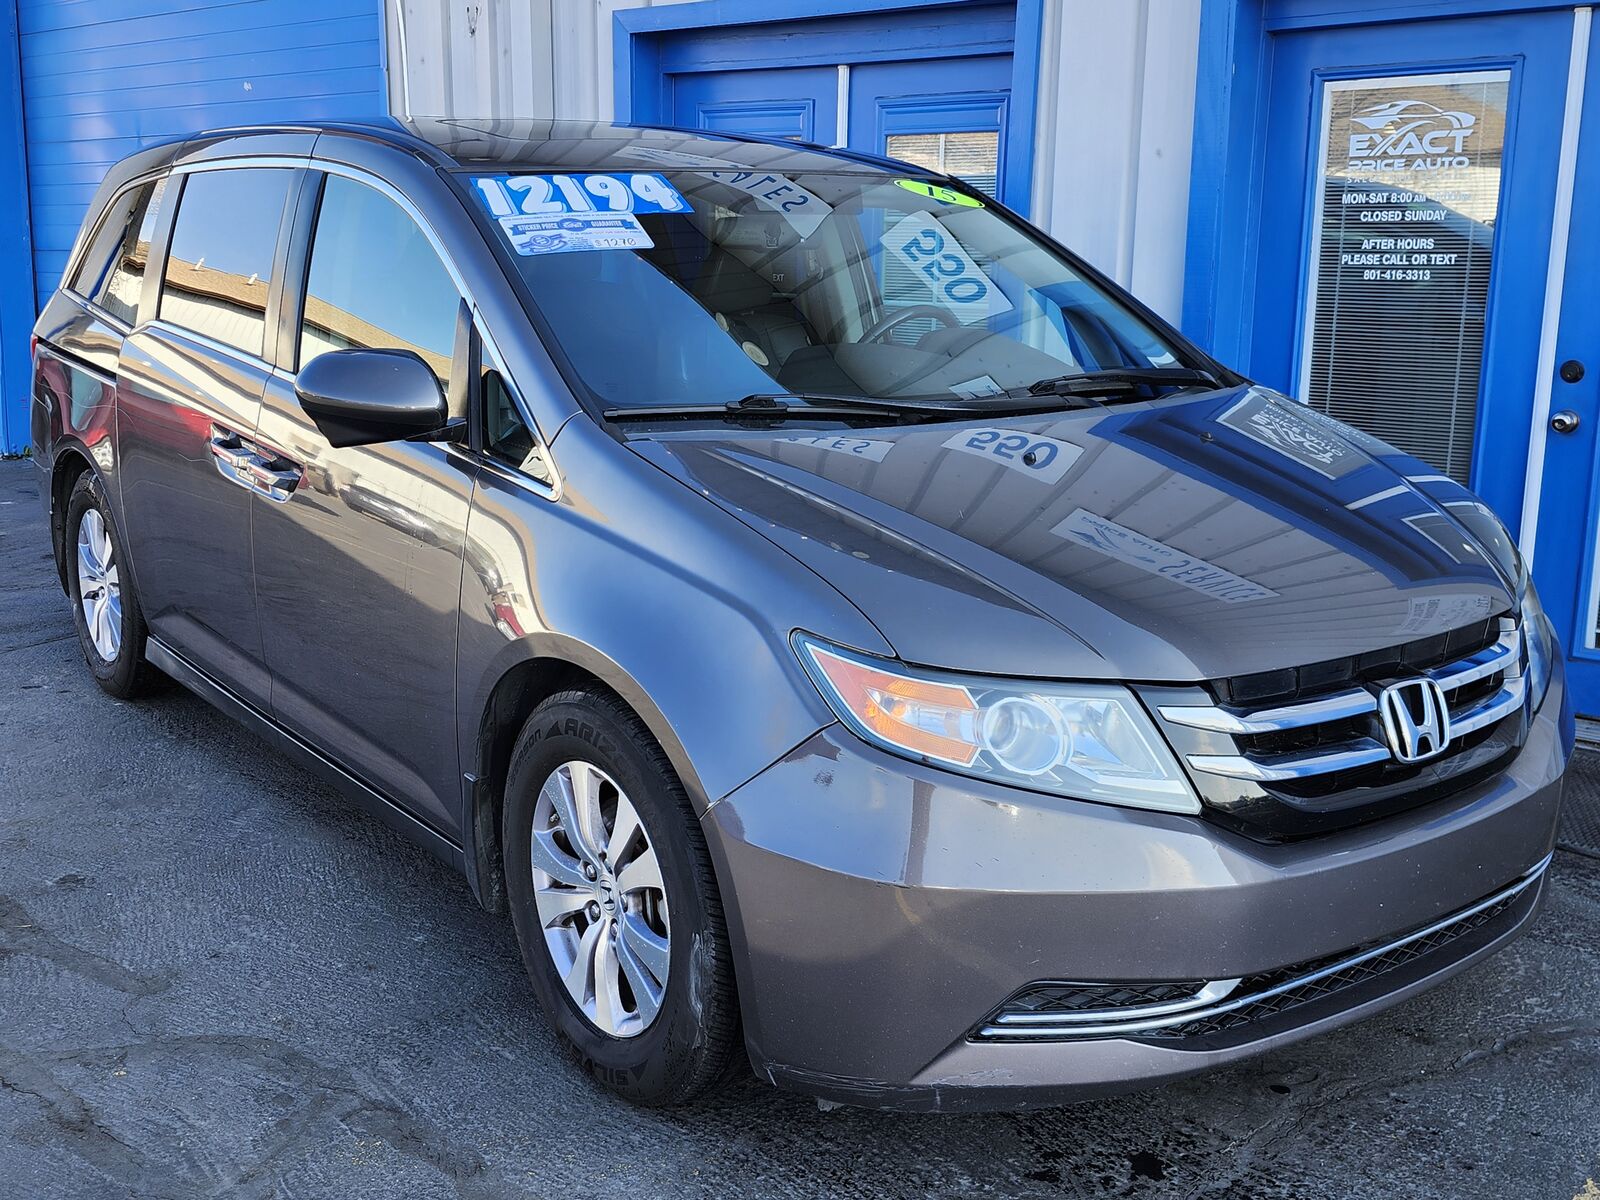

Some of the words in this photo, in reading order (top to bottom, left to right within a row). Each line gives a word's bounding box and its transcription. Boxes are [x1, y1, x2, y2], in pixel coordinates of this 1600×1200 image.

[1350, 129, 1474, 156] EXACT
[1348, 158, 1406, 172] PRICE
[1410, 156, 1470, 171] AUTO
[477, 174, 684, 216] 12194
[927, 186, 957, 201] 15
[1342, 193, 1389, 205] MON-SAT
[1390, 192, 1413, 203] 8:00
[1413, 194, 1426, 203] AM
[1360, 211, 1402, 222] CLOSED
[1404, 210, 1447, 221] SUNDAY
[517, 223, 541, 231] STICKER
[542, 222, 559, 230] PRICE
[1362, 239, 1395, 250] AFTER
[1397, 238, 1434, 249] HOURS
[1342, 254, 1380, 265] PLEASE
[1382, 254, 1410, 265] CALL
[1411, 254, 1427, 265] OR
[1429, 254, 1458, 265] TEXT
[1363, 270, 1430, 281] 801-416-3313
